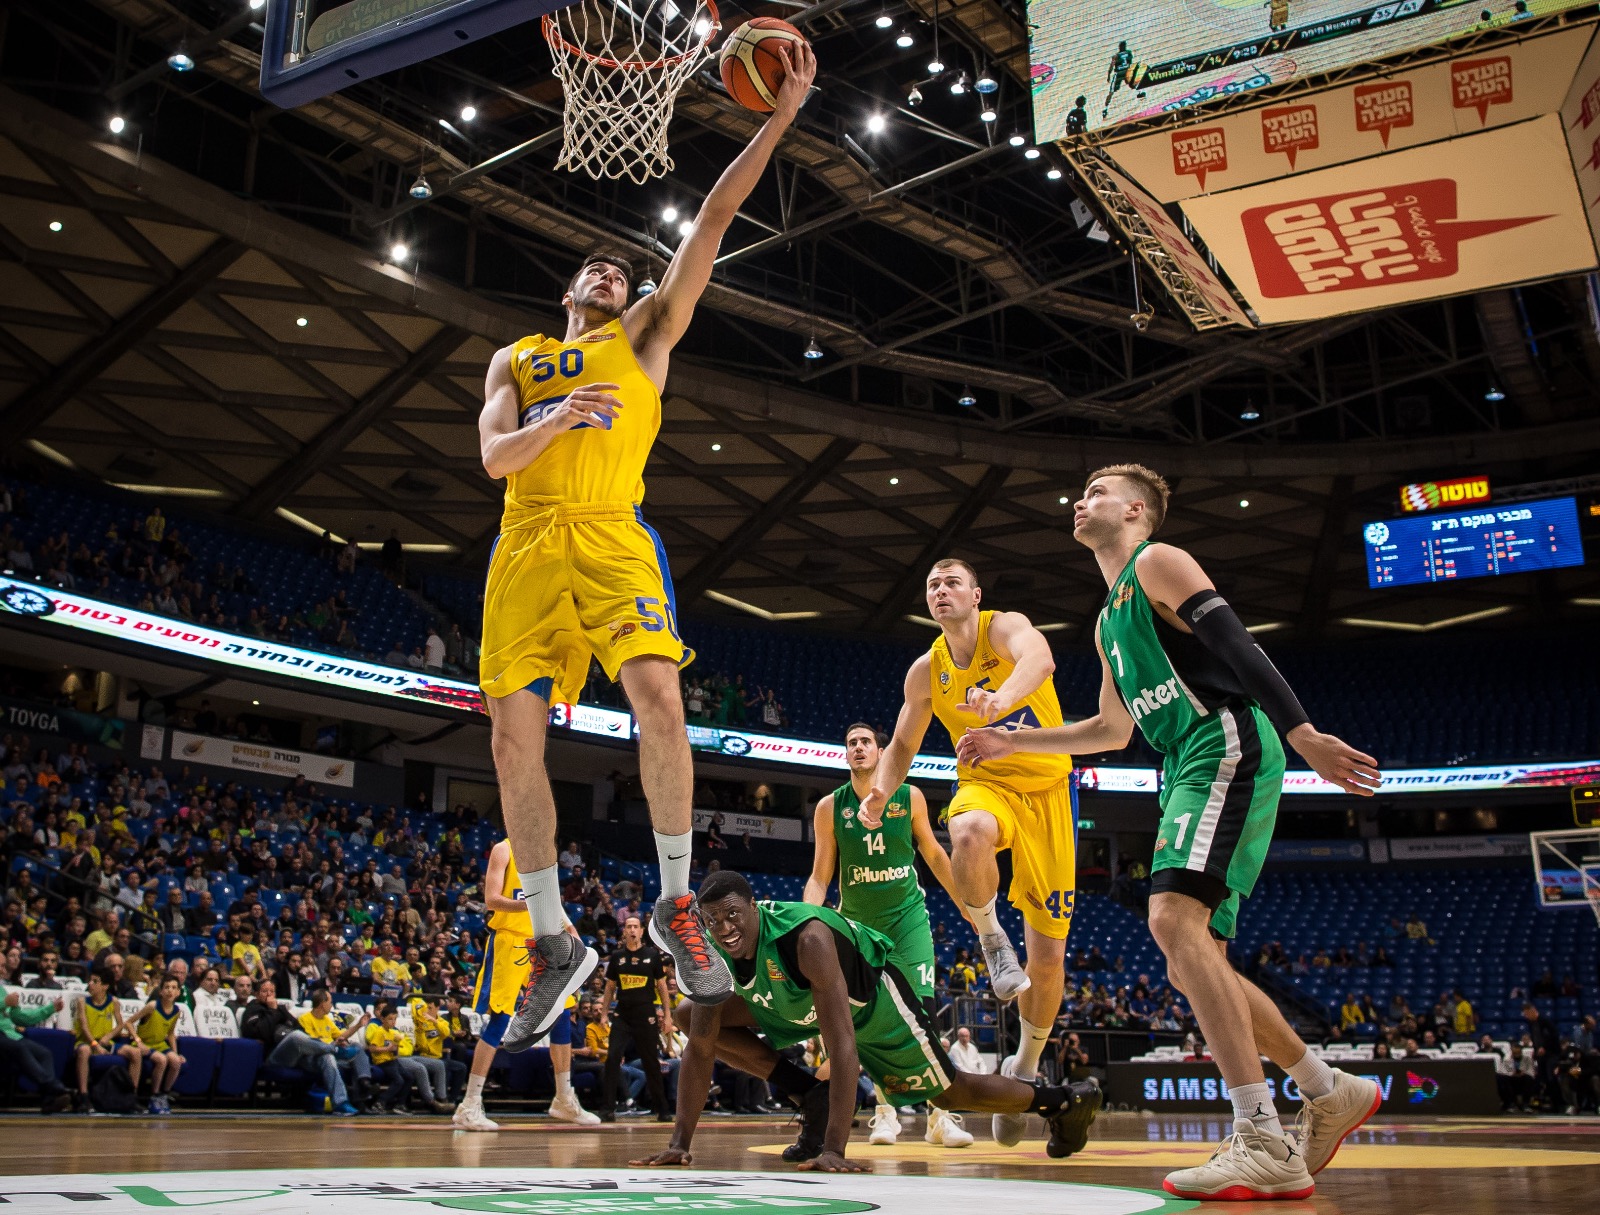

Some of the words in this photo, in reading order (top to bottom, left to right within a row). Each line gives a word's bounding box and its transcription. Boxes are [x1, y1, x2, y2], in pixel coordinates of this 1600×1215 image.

[1453, 60, 1509, 84] מעדני
[1356, 85, 1410, 108] מעדני
[1457, 75, 1511, 100] הטלה
[1263, 108, 1315, 131] מעדני
[1360, 100, 1411, 124] הטלה
[1173, 131, 1223, 152] מעדני
[1268, 123, 1317, 146] הטלה
[1178, 146, 1225, 168] הטלה
[1264, 202, 1355, 293] מעדני
[1329, 191, 1420, 281] הטלה
[531, 348, 584, 383] 50
[1440, 480, 1489, 502] טוטו
[1497, 508, 1532, 523] מכבי
[133, 620, 221, 648] נוסעים
[223, 643, 311, 668] ובחזרה
[1111, 640, 1125, 678] 1
[314, 662, 410, 686] למשחק
[1131, 677, 1180, 720] nter
[8, 706, 60, 733] TOYGA
[273, 751, 301, 764] מנורה
[797, 747, 848, 760] וסעים
[1443, 771, 1513, 785] למשחק
[1173, 812, 1193, 850] 1
[862, 832, 886, 856] 14
[860, 865, 911, 883] Hunter
[1044, 890, 1074, 919] 45
[917, 963, 936, 988] 14
[905, 1066, 939, 1091] 21
